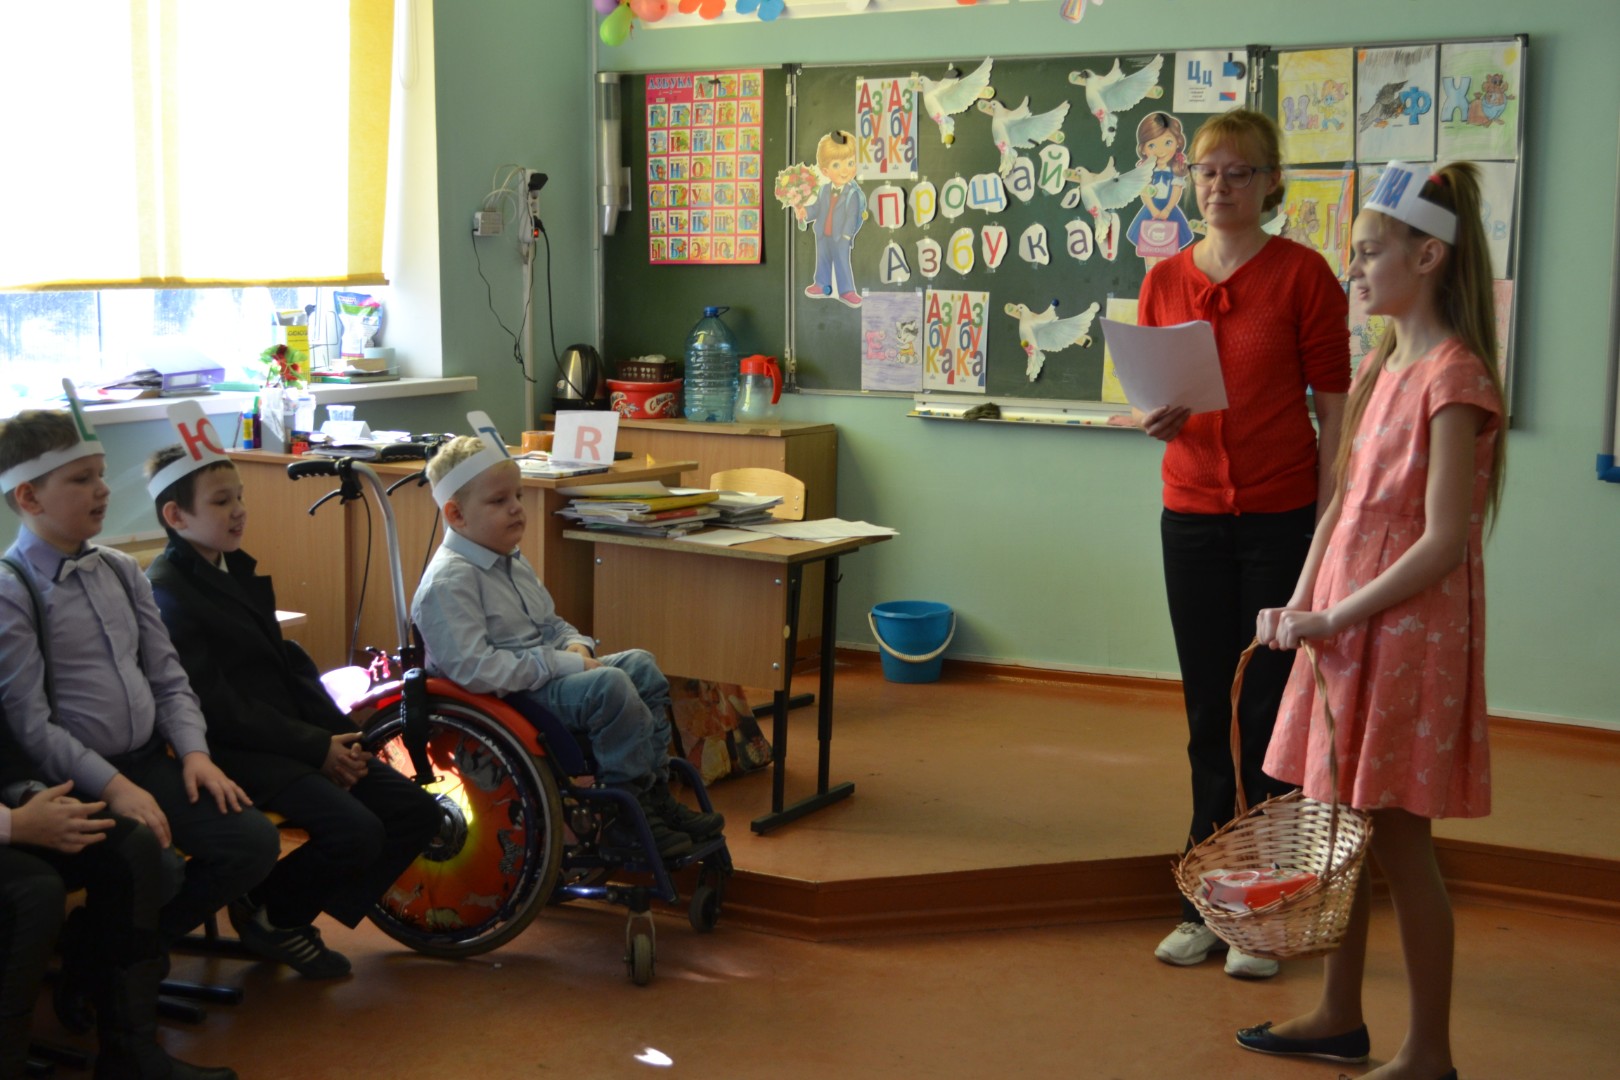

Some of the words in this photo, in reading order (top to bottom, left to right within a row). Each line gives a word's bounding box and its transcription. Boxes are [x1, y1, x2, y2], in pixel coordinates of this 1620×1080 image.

[647, 75, 693, 90] АЗБУКА
[695, 83, 705, 99] А
[1400, 86, 1432, 125] Ф
[1440, 76, 1472, 123] Х
[692, 161, 704, 178] О
[670, 189, 679, 205] Т
[692, 188, 701, 205] У
[177, 417, 226, 462] Ю
[574, 425, 602, 461] R
